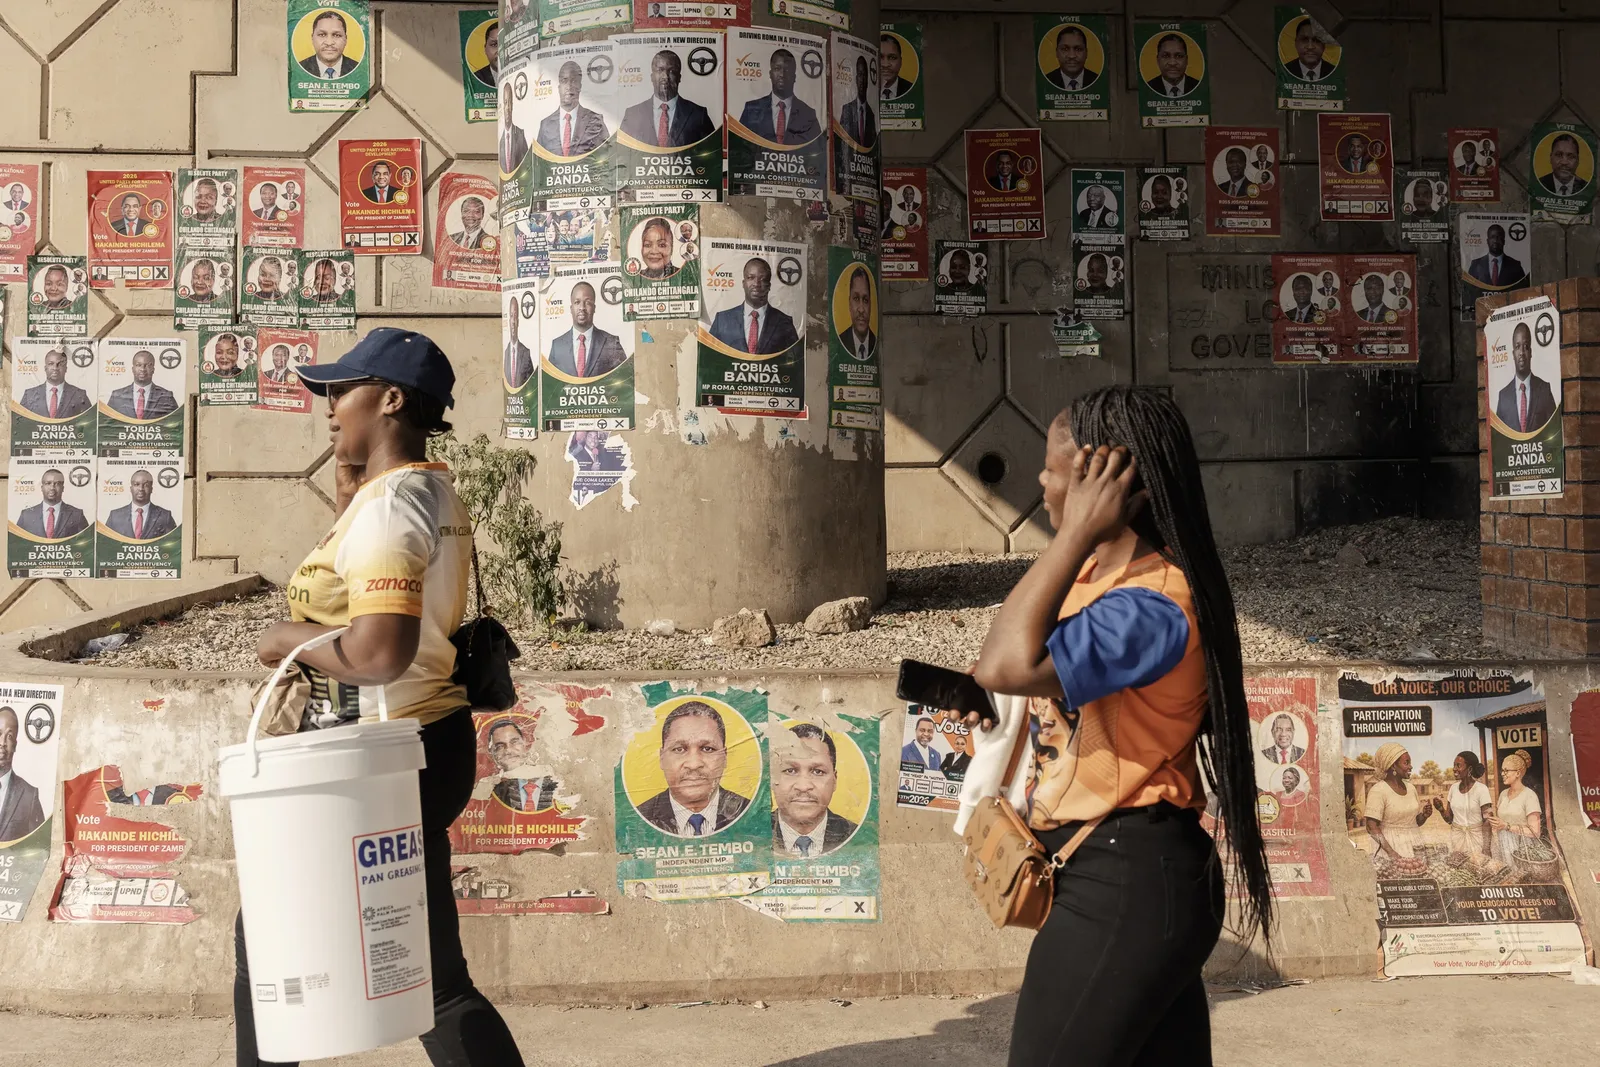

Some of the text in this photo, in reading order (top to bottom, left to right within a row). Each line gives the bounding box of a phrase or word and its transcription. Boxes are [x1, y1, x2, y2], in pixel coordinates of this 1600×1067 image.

[739, 31, 761, 40] DRIVING
[762, 33, 777, 41] ROMA
[618, 73, 643, 83] 2026
[735, 67, 762, 78] 2026
[539, 79, 552, 87] VOTE
[534, 87, 553, 97] 2026
[642, 156, 692, 166] TOBIAS
[762, 151, 804, 164] TOBIAS
[551, 164, 589, 175] TOBIAS
[635, 165, 695, 177] BANDA
[755, 161, 807, 175] BANDA
[546, 174, 592, 186] BANDA
[648, 178, 709, 186] CONSTITUENCY
[767, 174, 818, 185] CONSTITUENCY
[539, 185, 604, 196] ROMA CONSTITUENCY
[632, 206, 685, 216] RESOLUTE PARTY
[711, 242, 734, 250] DRIVING
[735, 243, 751, 251] ROMA
[751, 243, 758, 251] IN
[764, 244, 775, 253] NEW
[776, 246, 802, 256] DIRECTION
[707, 278, 735, 288] 2026
[624, 284, 699, 297] CHILANDO CHITANGALA
[545, 305, 565, 316] 2026
[1496, 344, 1507, 352] VOTE
[1491, 352, 1509, 365] 2026
[732, 362, 779, 373] TOBIAS
[724, 371, 781, 384] BANDA
[564, 385, 606, 396] TOBIAS
[711, 384, 793, 394] ROMA CONSTITUENCY
[559, 395, 609, 406] BANDA
[37, 424, 75, 432] TOBIAS
[124, 425, 161, 433] TOBIAS
[31, 431, 77, 440] BANDA
[118, 432, 163, 440] BANDA
[1511, 441, 1543, 455] TOBIAS
[1508, 452, 1546, 467] BANDA
[1501, 467, 1555, 478] ROMA CONSTITUENCY
[122, 545, 160, 553] TOBIAS
[28, 551, 74, 560] BANDA
[116, 552, 162, 561] BANDA
[365, 577, 422, 594] zanaco
[1258, 687, 1294, 695] NATIONAL
[1373, 680, 1511, 696] OUR VOICE, OUR CHOICE
[13, 689, 57, 700] NEW DIRECTION
[1353, 709, 1422, 721] PARTICIPATION
[1351, 722, 1426, 733] THROUGH VOTING
[1500, 727, 1538, 744] VOTE
[909, 795, 930, 805] 2026
[75, 814, 101, 825] Vote
[461, 824, 524, 834] HAKAINDE
[1260, 828, 1296, 836] KASIKILI
[78, 830, 136, 841] HAKAINDE
[493, 837, 536, 845] PRESIDENT
[537, 837, 548, 845] OF
[635, 846, 679, 859] SEAN
[699, 840, 754, 855] TEMBO
[680, 865, 734, 874] CONSTITUENCY
[808, 865, 861, 877] TEMBO
[361, 872, 384, 885] PAN
[748, 877, 760, 889] X
[1479, 887, 1525, 899] JOIN US!
[854, 901, 865, 913] X
[1456, 901, 1476, 909] YOUR
[1476, 900, 1519, 908] DEMOCRACY
[1543, 898, 1556, 906] YOU
[1479, 907, 1541, 921] TO VOTE!
[1448, 960, 1464, 968] Vote,
